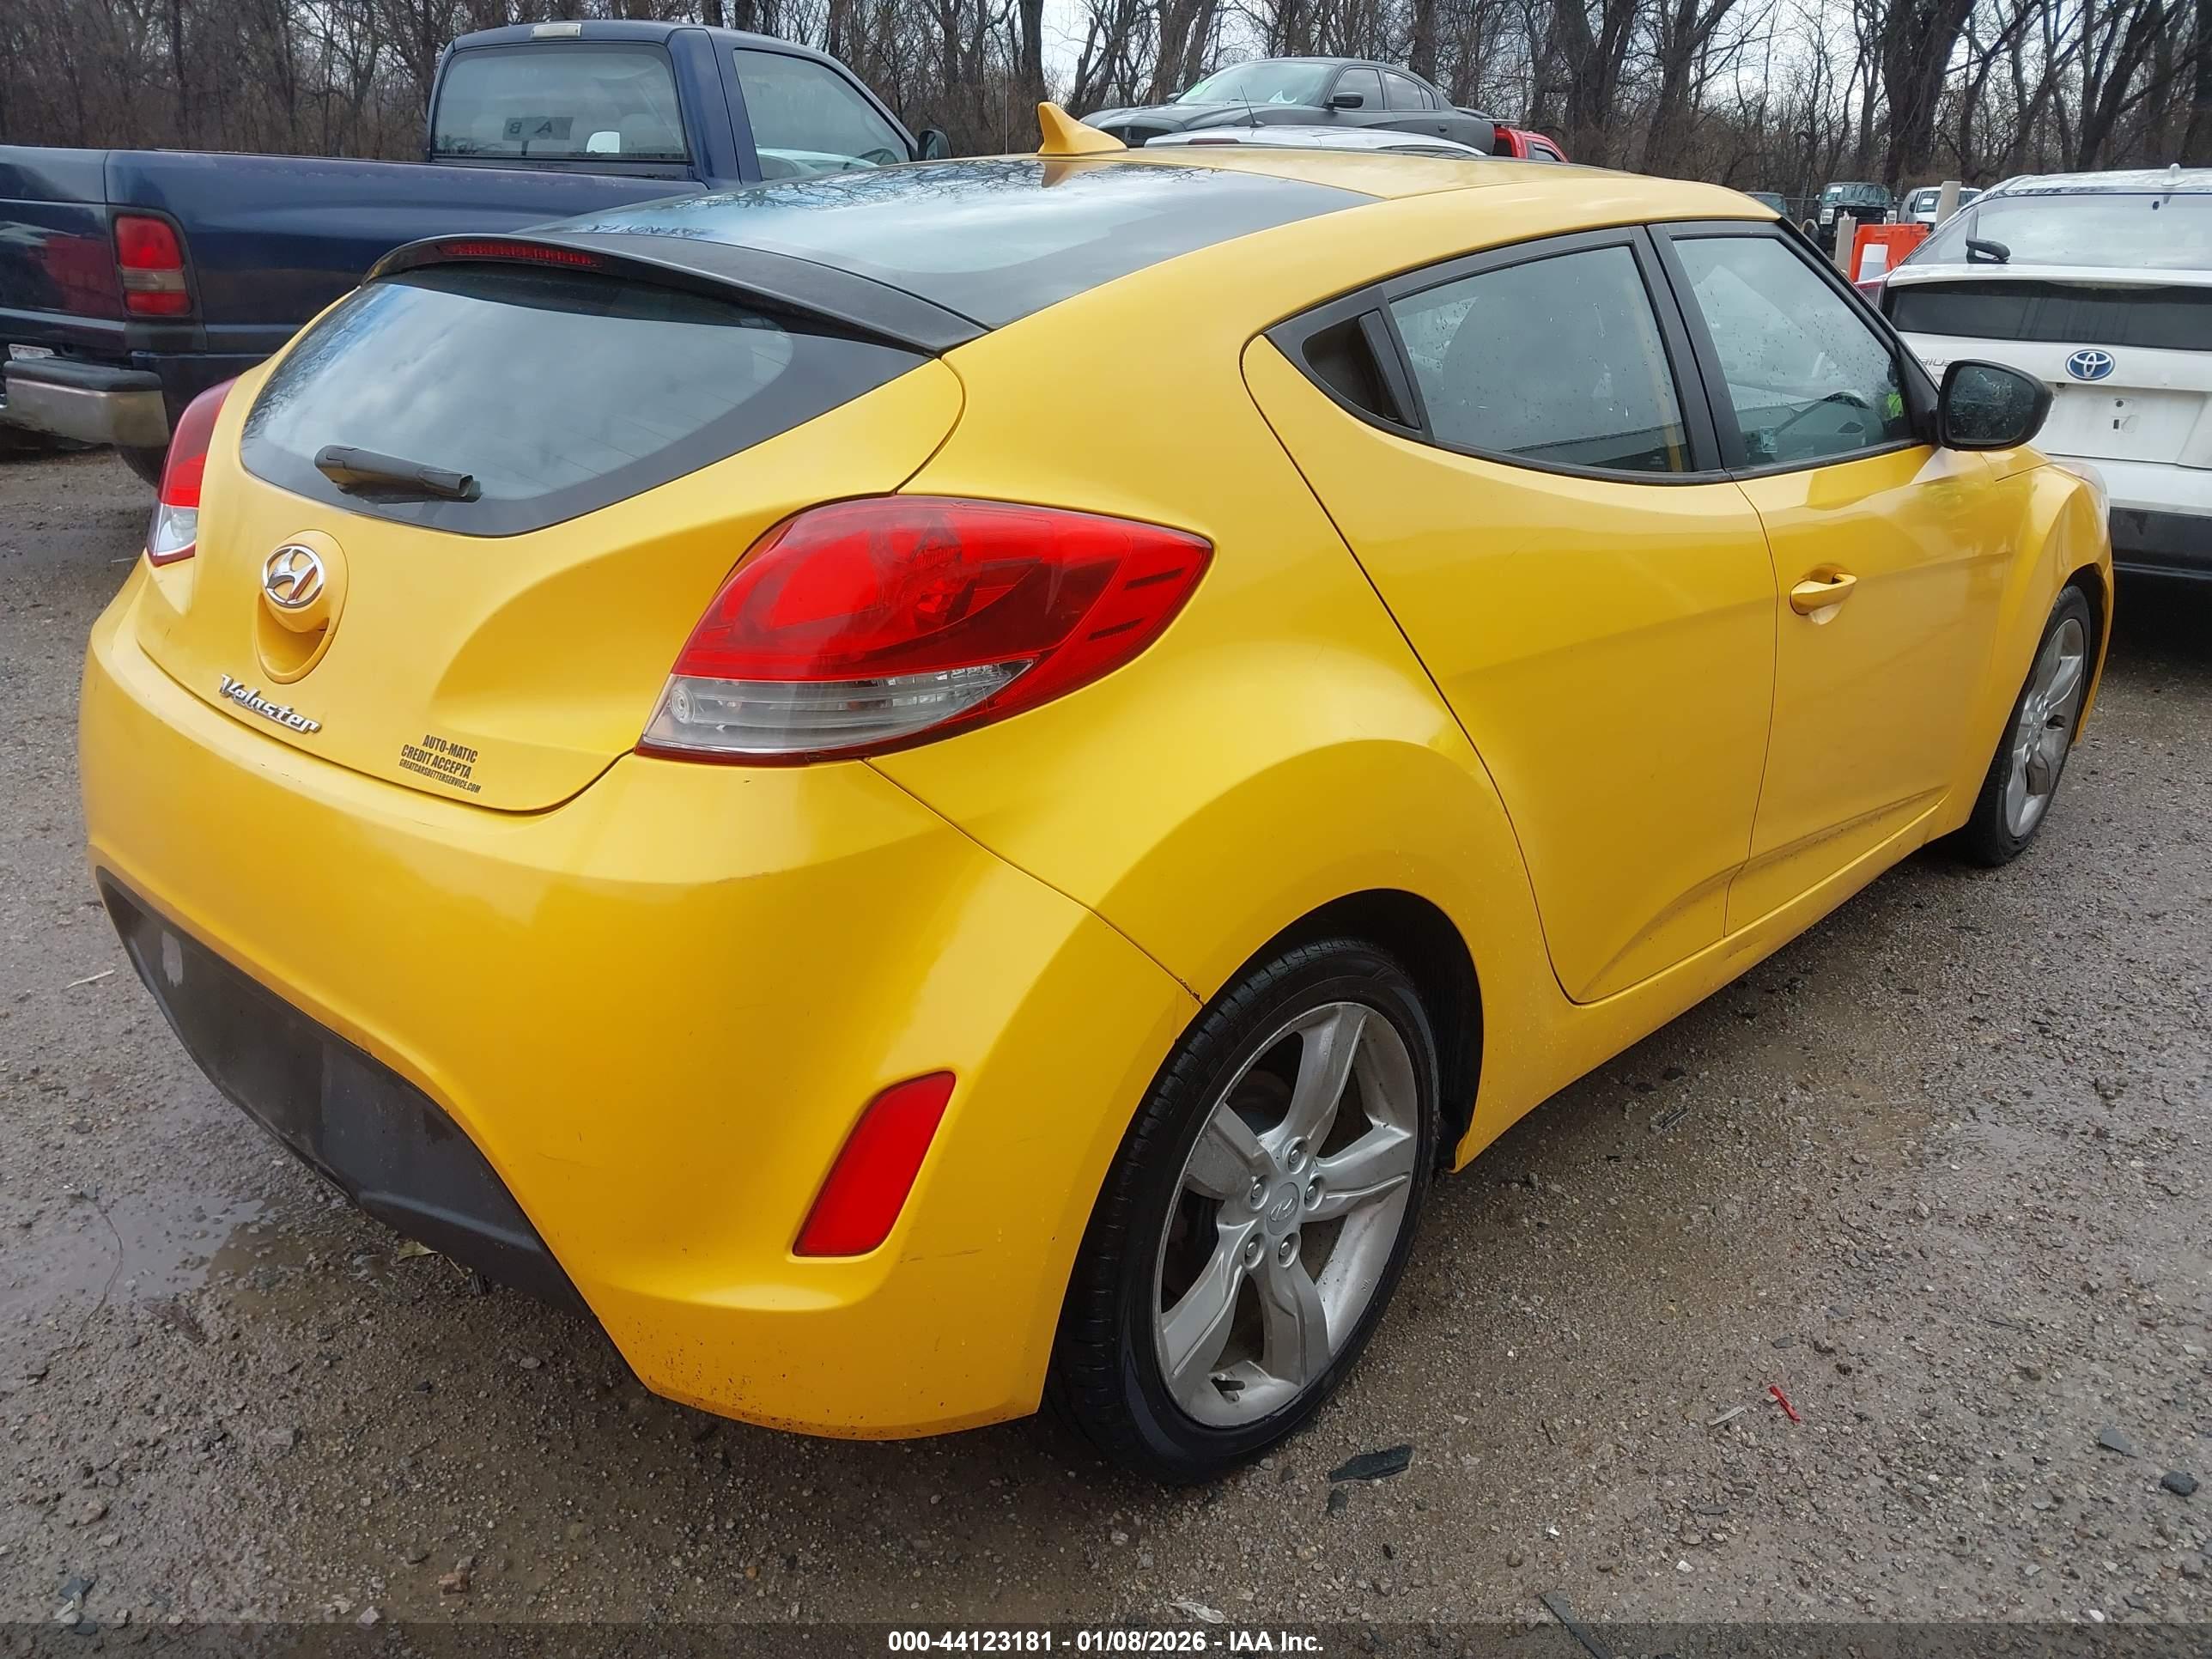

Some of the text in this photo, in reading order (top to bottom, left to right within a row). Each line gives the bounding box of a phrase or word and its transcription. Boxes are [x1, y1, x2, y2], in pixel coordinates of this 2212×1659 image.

[1919, 358, 1954, 367] RIUS
[218, 673, 322, 734] Veloster
[401, 744, 472, 779] CREDIT ACCEPTA
[422, 734, 478, 763] AUTO-MATIC
[398, 758, 482, 793] GREATCARSBETTERSERVICE.COM
